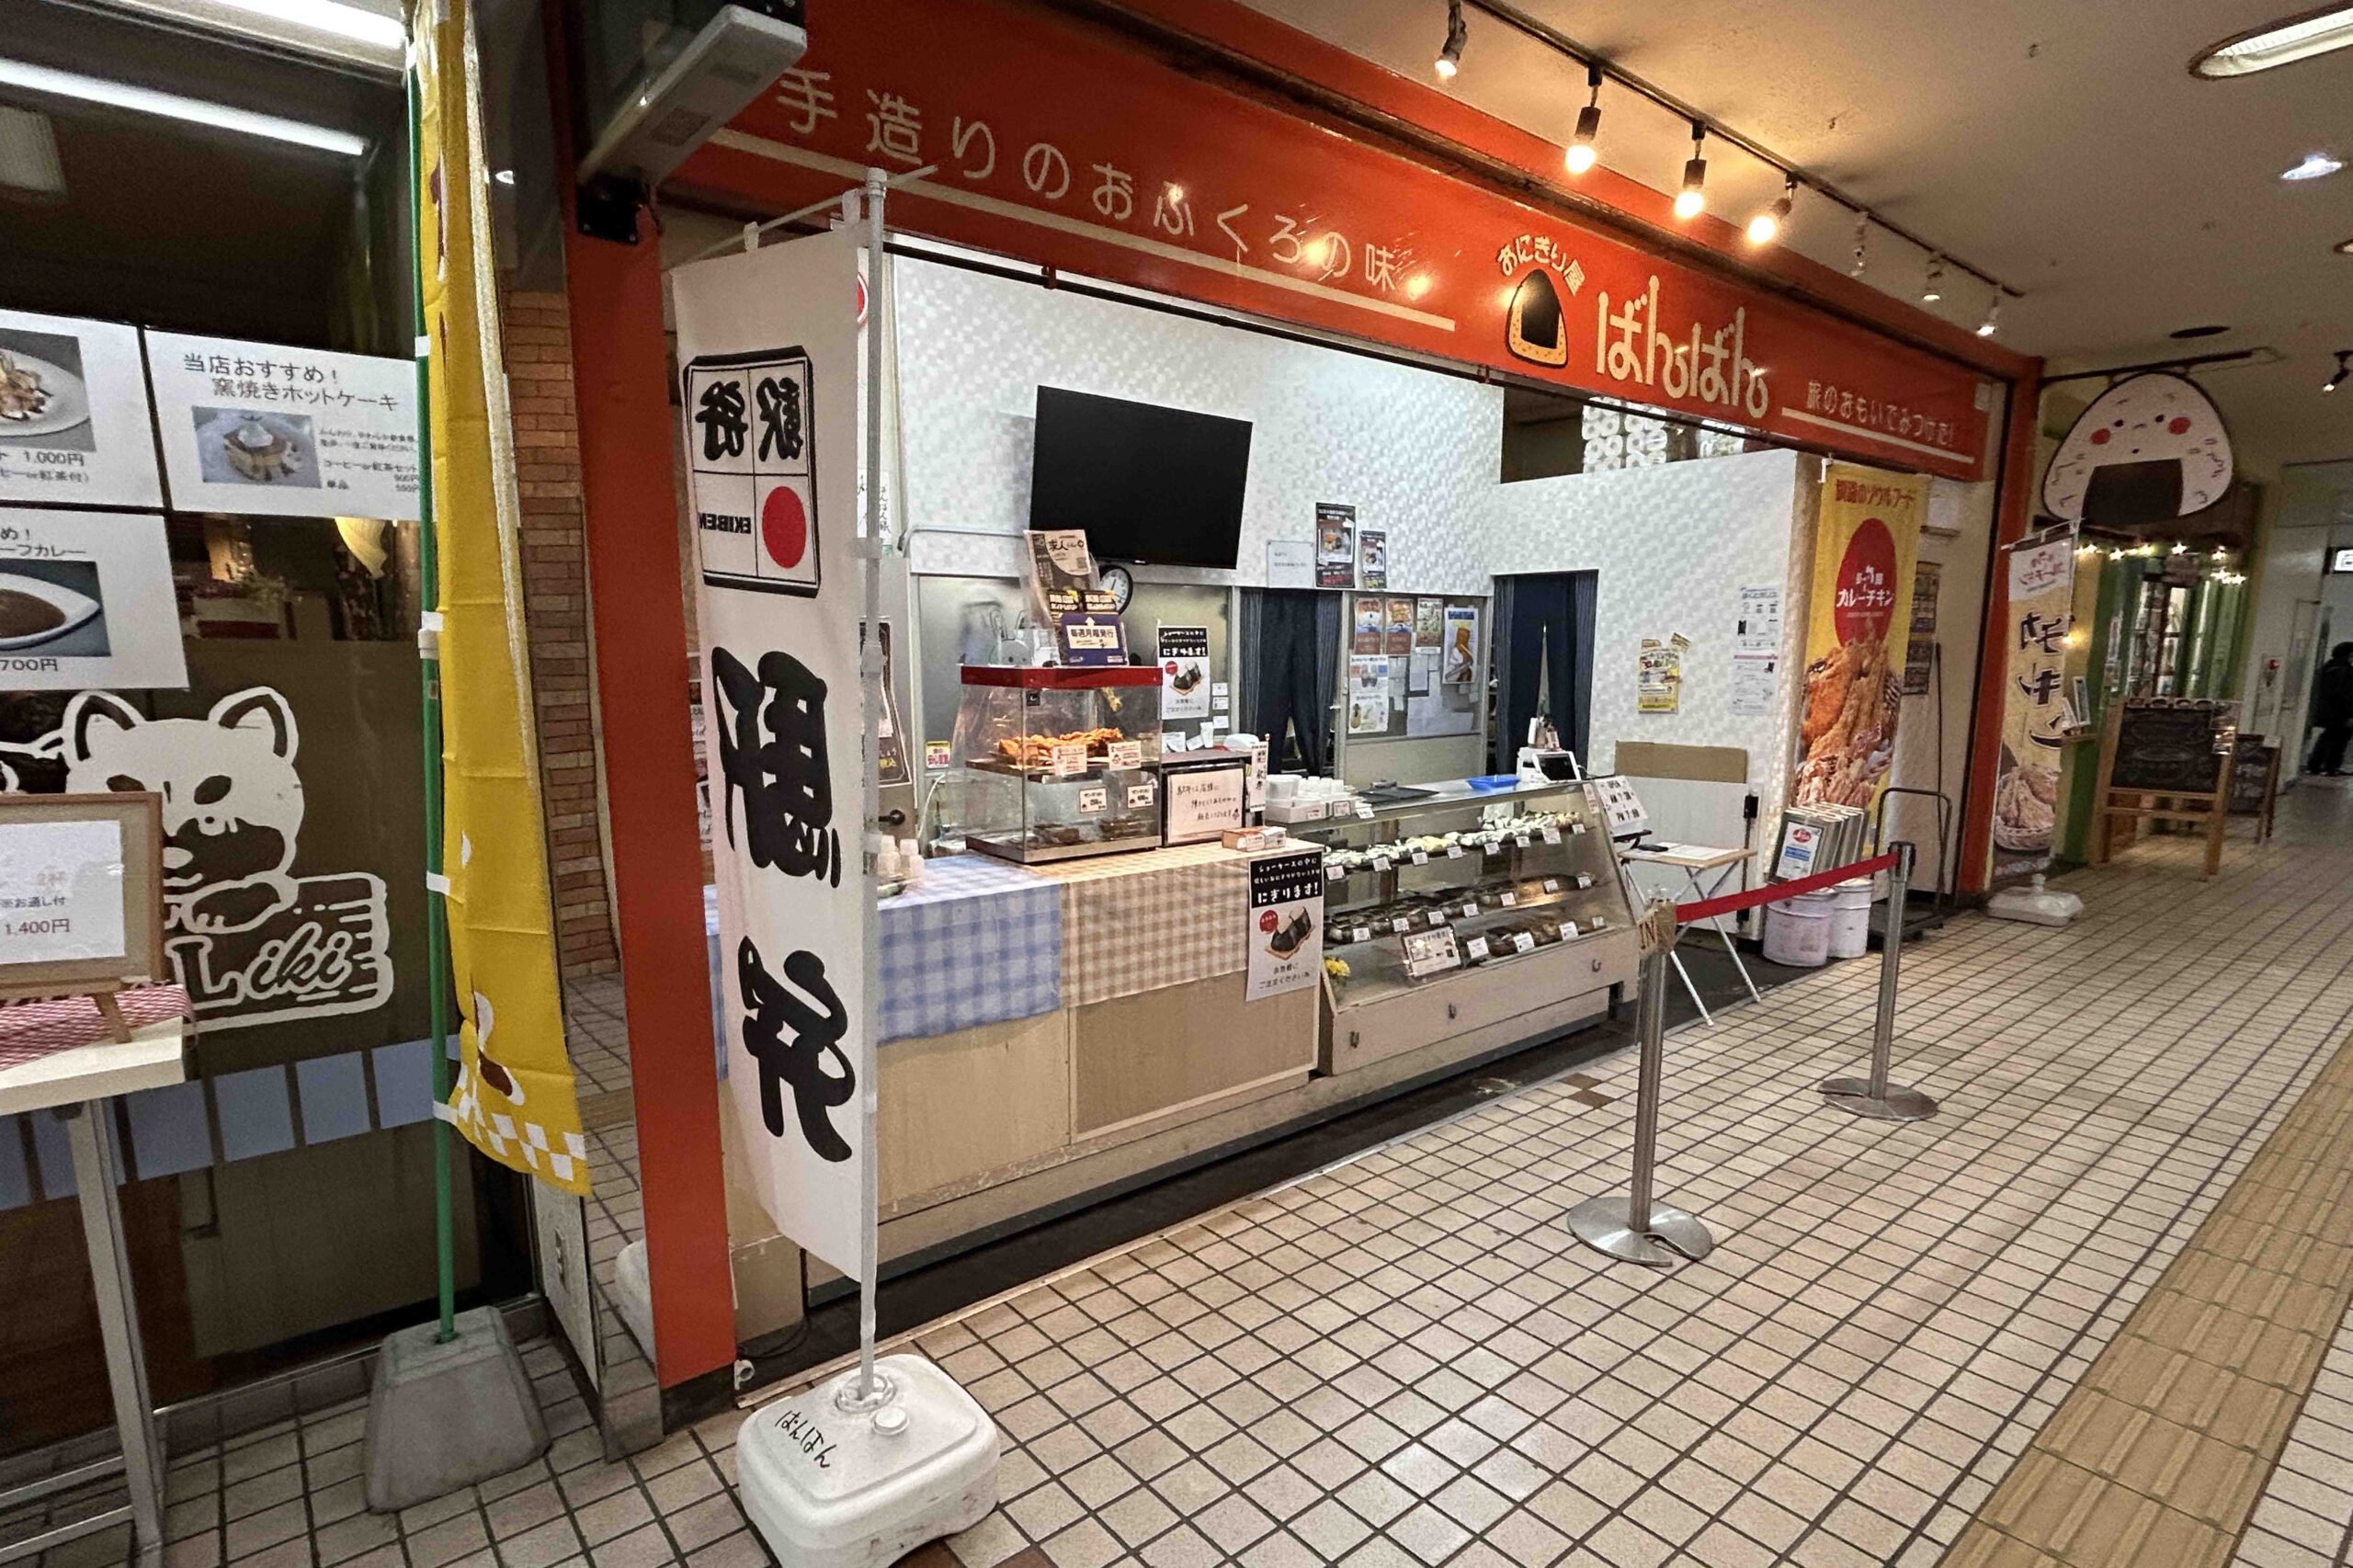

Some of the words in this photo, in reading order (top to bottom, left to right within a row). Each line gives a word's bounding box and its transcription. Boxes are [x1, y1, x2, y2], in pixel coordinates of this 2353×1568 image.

[777, 68, 1395, 292] 手造りのおふくろの味
[1596, 275, 1768, 419] ばんばん
[211, 378, 399, 411] 窯焼きホットケーキ
[1836, 588, 1894, 608] カレーチキン
[0, 658, 58, 672] 700円
[1258, 858, 1317, 873] ショーケースの中に
[1257, 881, 1318, 904] にぎります!
[6, 919, 70, 935] 1,400円
